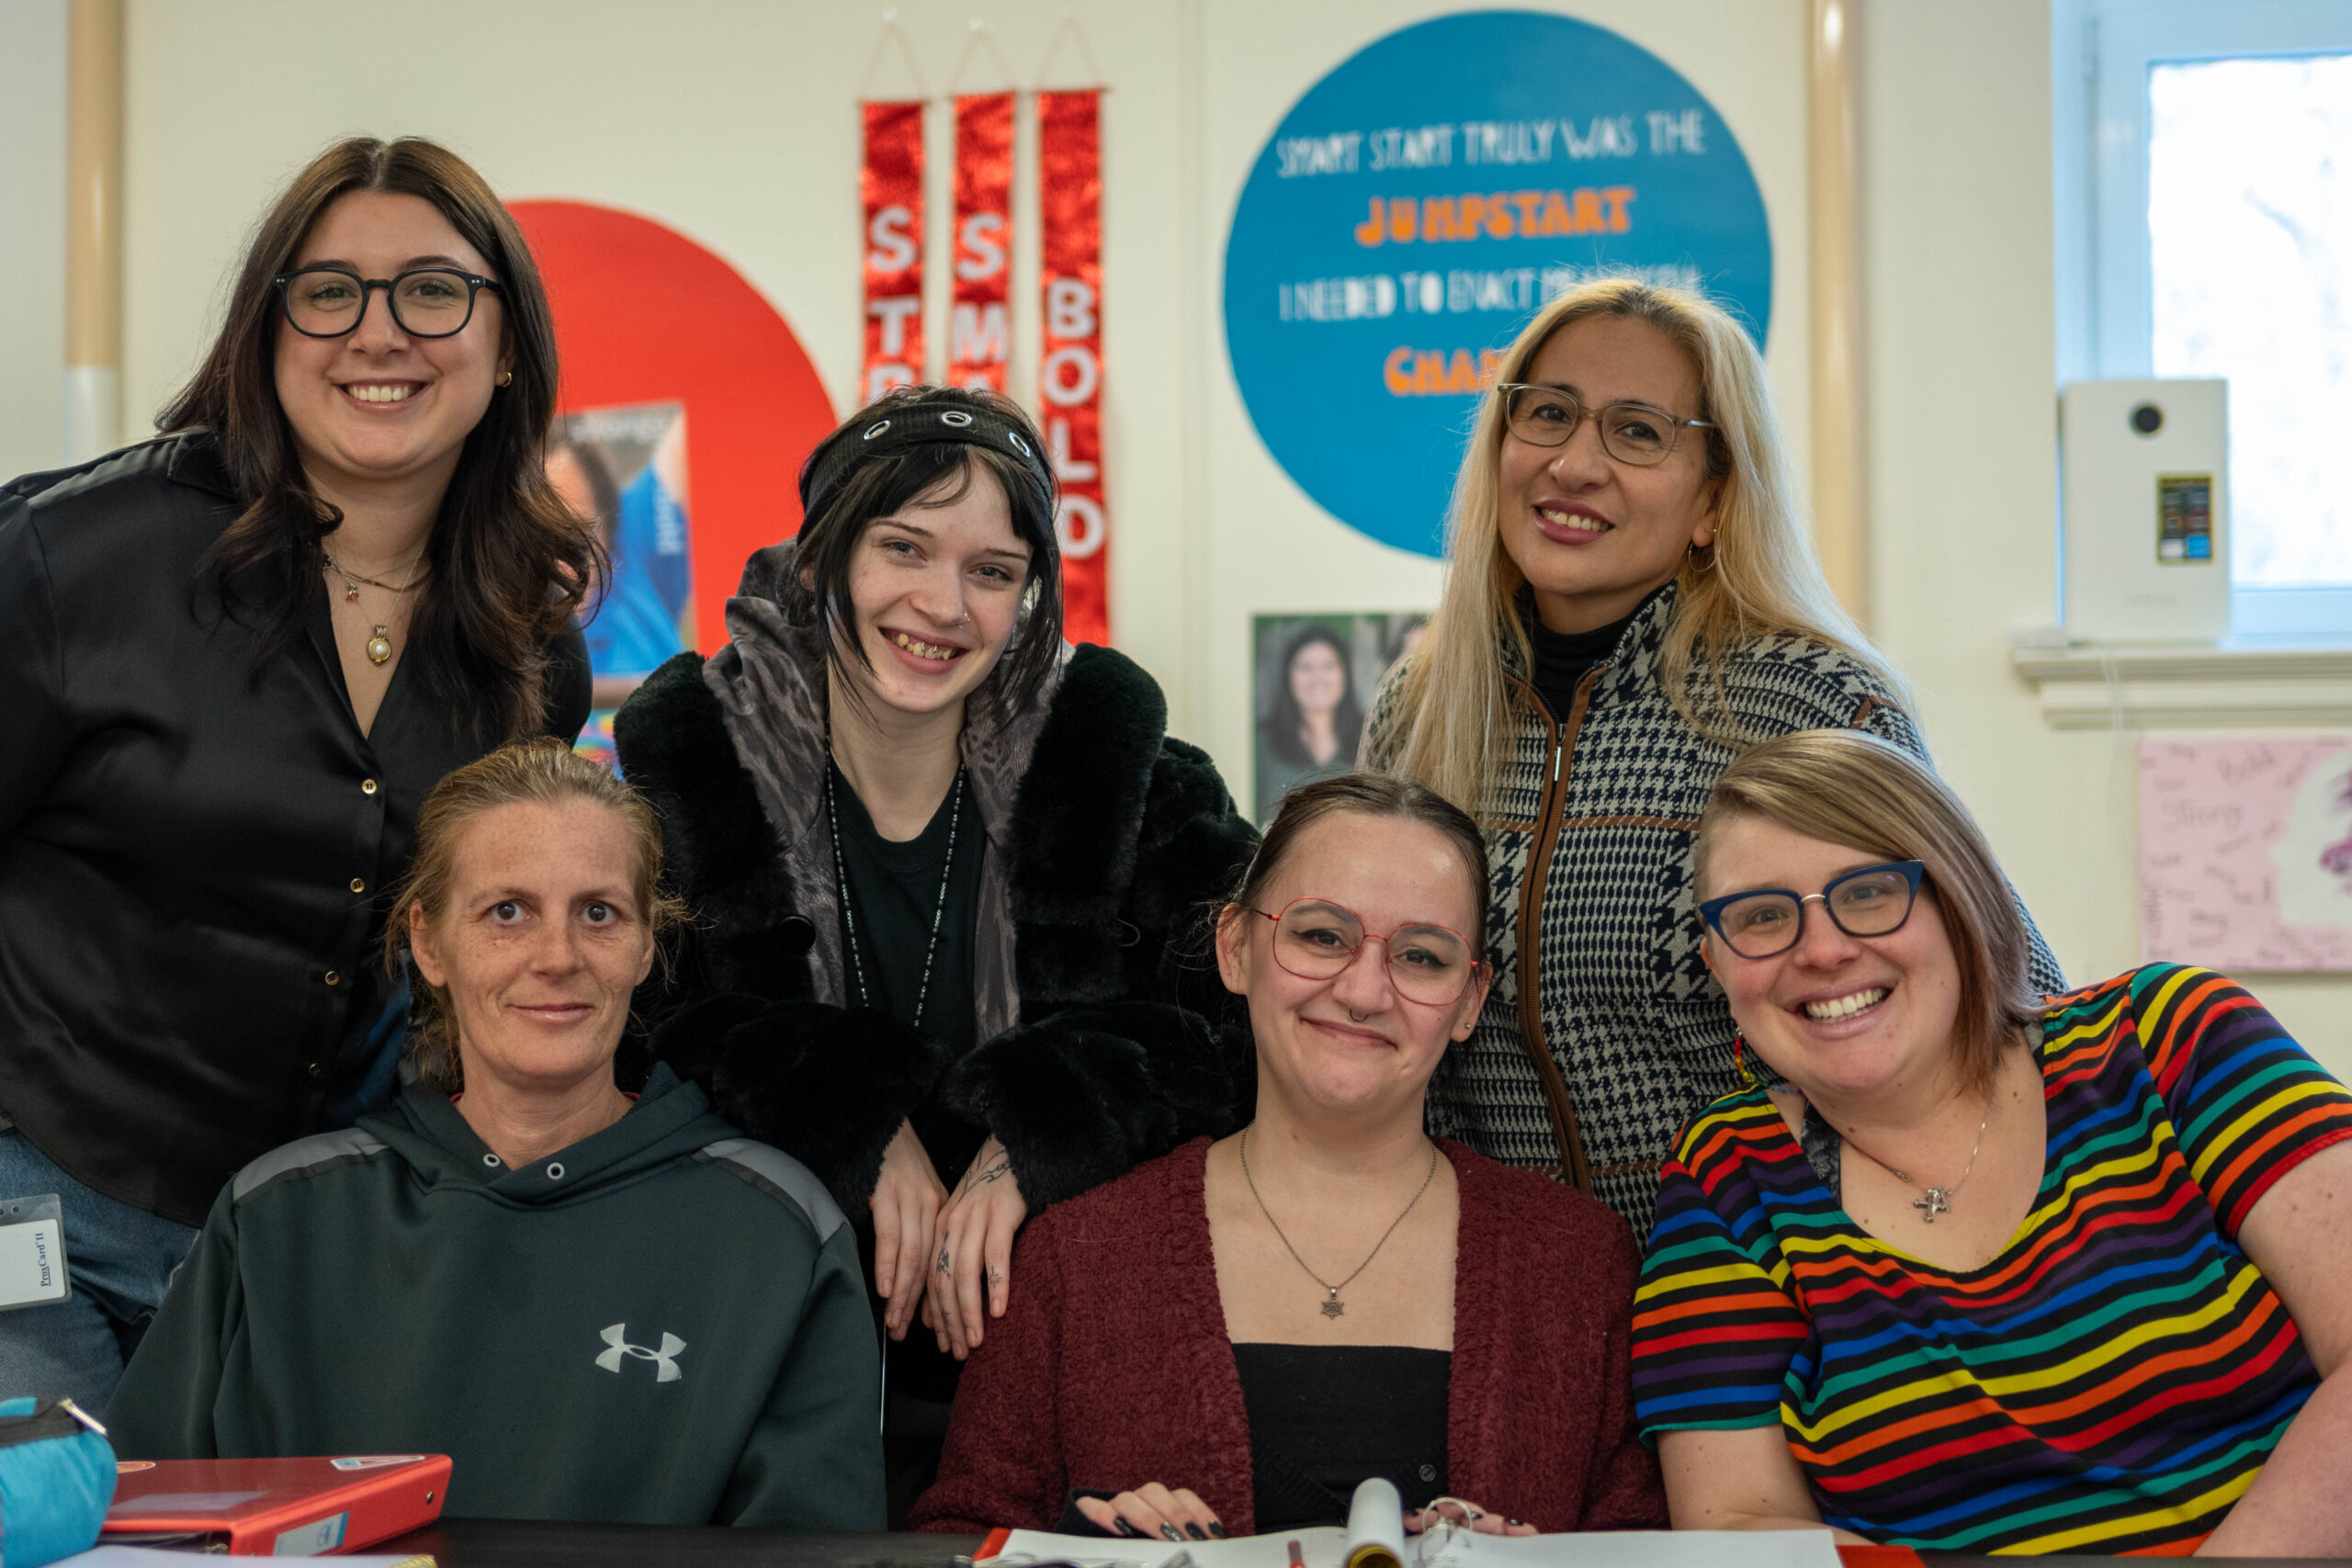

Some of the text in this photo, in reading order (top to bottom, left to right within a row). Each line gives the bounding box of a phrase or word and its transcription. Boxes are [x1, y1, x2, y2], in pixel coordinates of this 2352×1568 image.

[1276, 107, 1706, 178] SMART START TRULY WAS THE
[1354, 186, 1635, 247] JUMPSTART
[1294, 274, 1397, 322] NEEDED
[1400, 270, 1444, 314] TO
